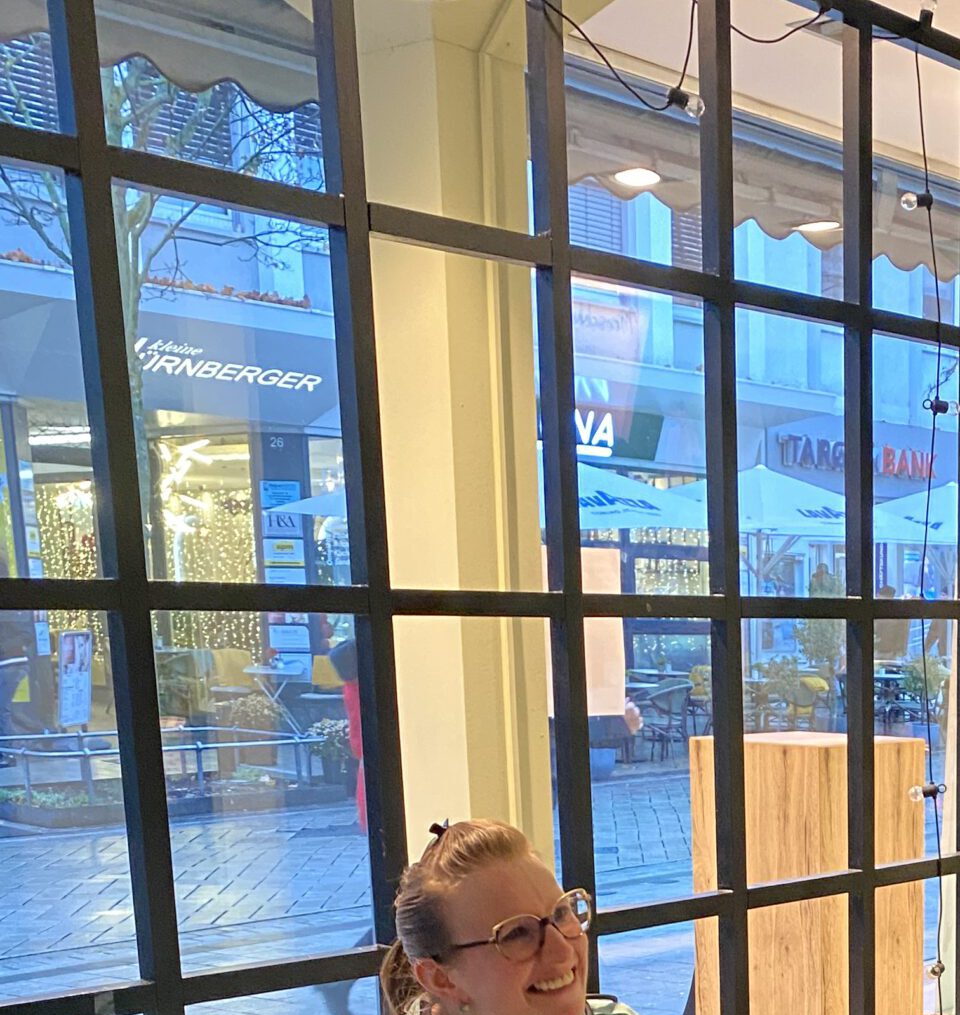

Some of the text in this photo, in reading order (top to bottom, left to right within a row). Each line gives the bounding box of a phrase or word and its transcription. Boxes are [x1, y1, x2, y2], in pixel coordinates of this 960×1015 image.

[148, 338, 203, 357] kleine
[134, 337, 322, 392] ÜRNBERGER
[269, 437, 284, 448] 26
[882, 443, 937, 480] BANK
